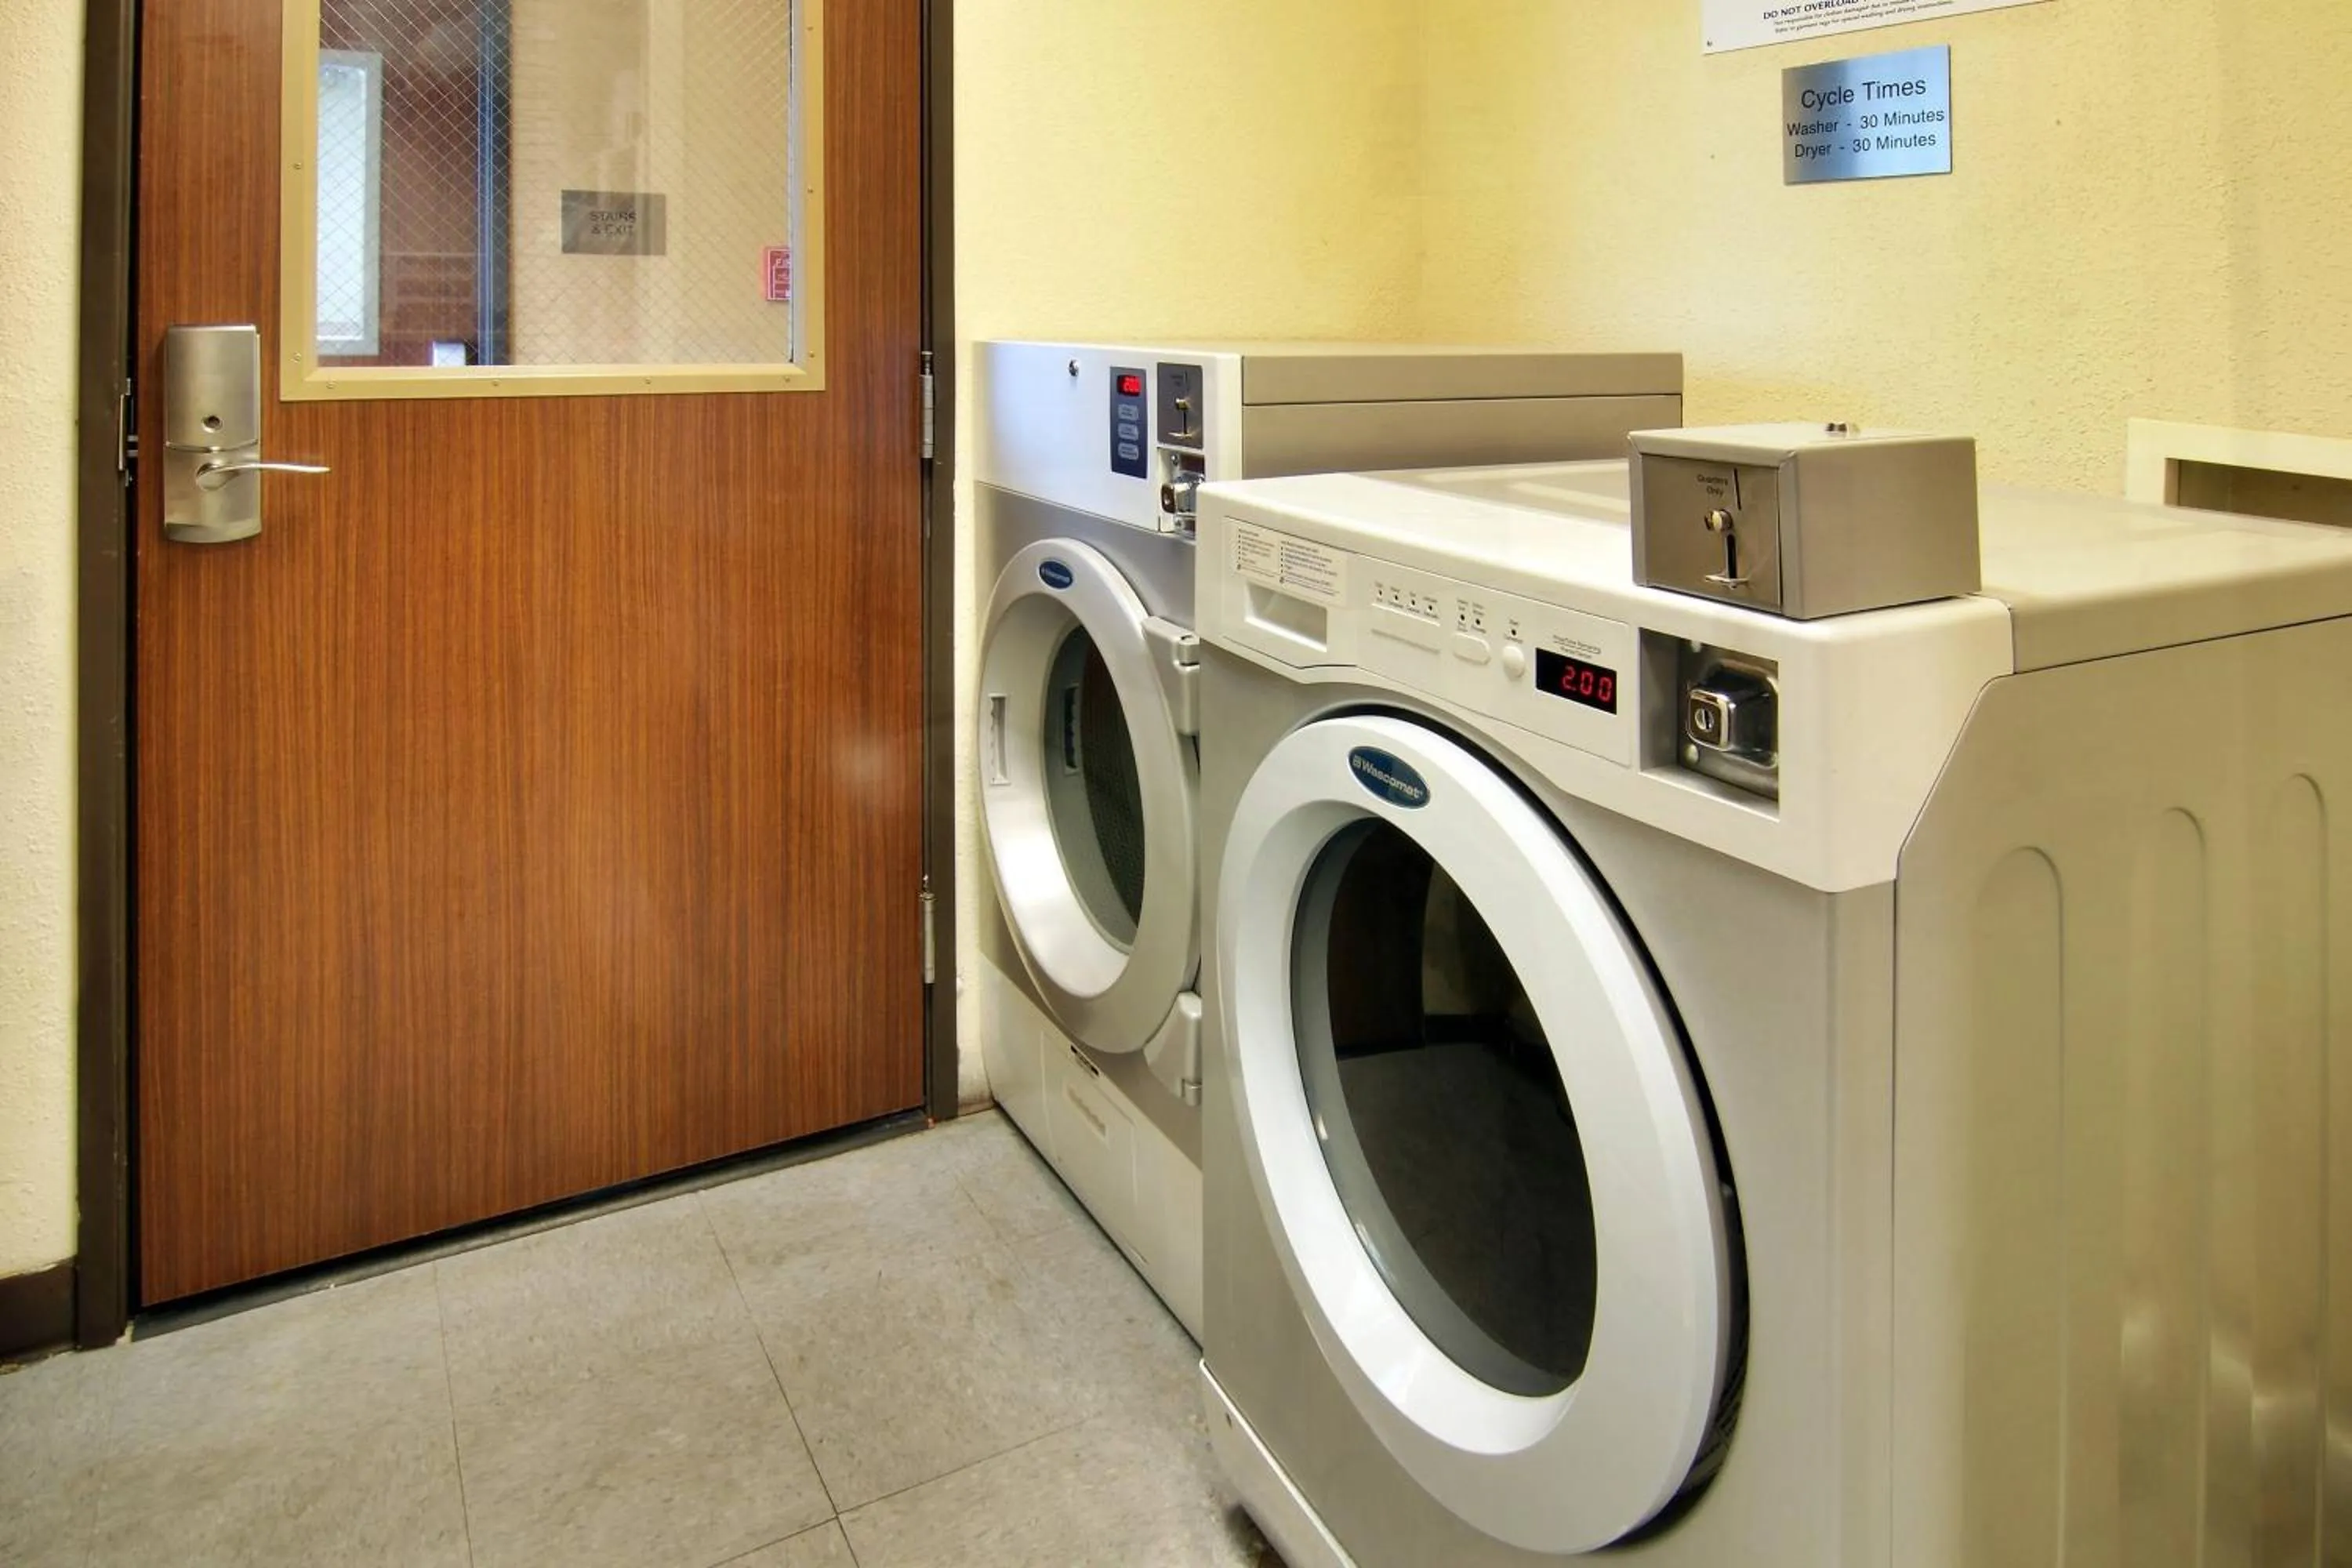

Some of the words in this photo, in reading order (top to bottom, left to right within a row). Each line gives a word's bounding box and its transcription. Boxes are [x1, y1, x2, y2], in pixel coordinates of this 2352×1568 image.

[1763, 10, 1779, 20] DO
[1781, 5, 1802, 16] NOT
[1801, 86, 1855, 111] Cycle
[1862, 79, 1927, 101] Times
[1787, 119, 1839, 136] Washer
[1860, 114, 1878, 129] 30
[1884, 109, 1945, 126] Minutes
[1795, 143, 1832, 160] Dryer
[1853, 137, 1871, 153] 30
[1876, 133, 1936, 151] Minutes
[589, 210, 637, 223] STAIRS
[1361, 758, 1421, 799] Wascomat
